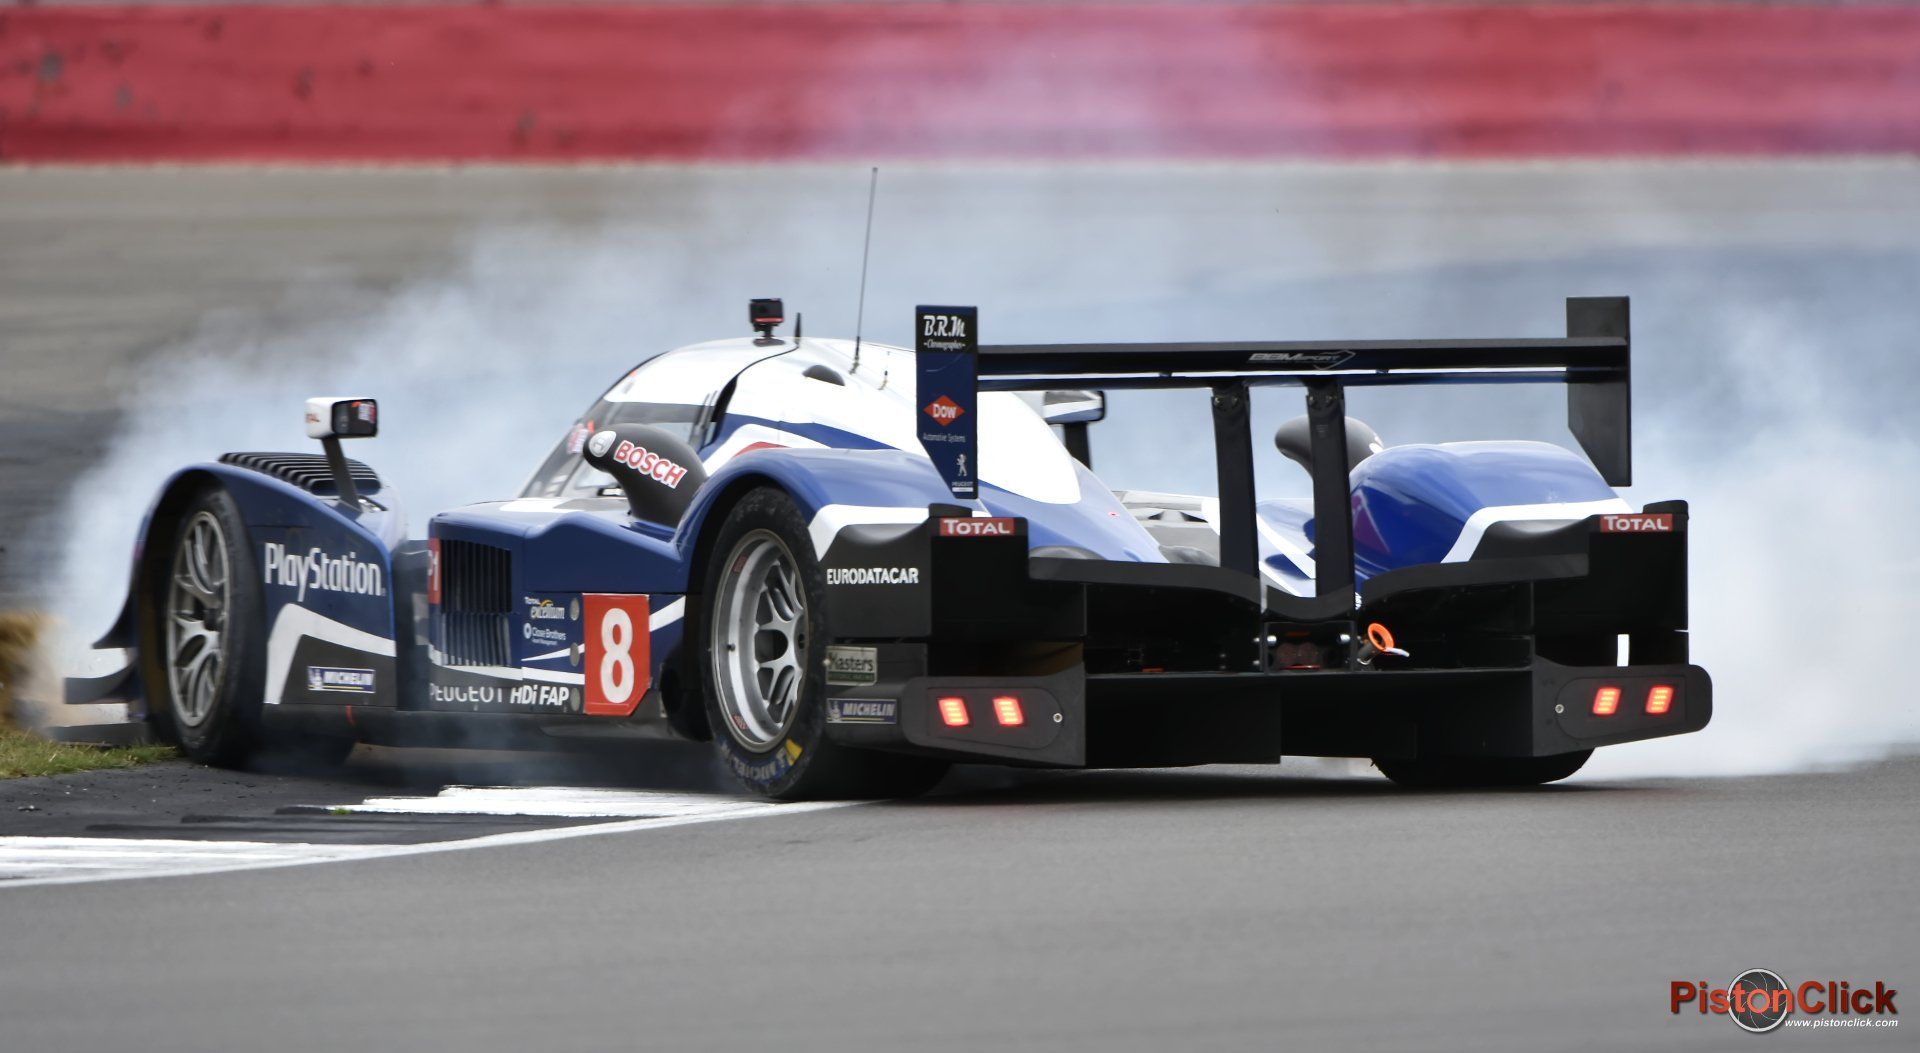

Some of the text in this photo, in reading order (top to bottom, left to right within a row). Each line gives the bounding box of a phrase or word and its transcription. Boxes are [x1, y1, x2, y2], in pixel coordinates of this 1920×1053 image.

[613, 440, 688, 489] BOSCH
[943, 518, 1010, 535] TOTAL
[1604, 515, 1669, 531] TOTAL
[264, 542, 382, 602] PlayStation
[826, 567, 919, 585] EURODATACAR
[600, 607, 634, 704] 8
[322, 670, 375, 686] MICHELIN
[509, 685, 538, 705] HDi
[539, 685, 570, 706] FAP
[842, 702, 896, 717] MICHELIN
